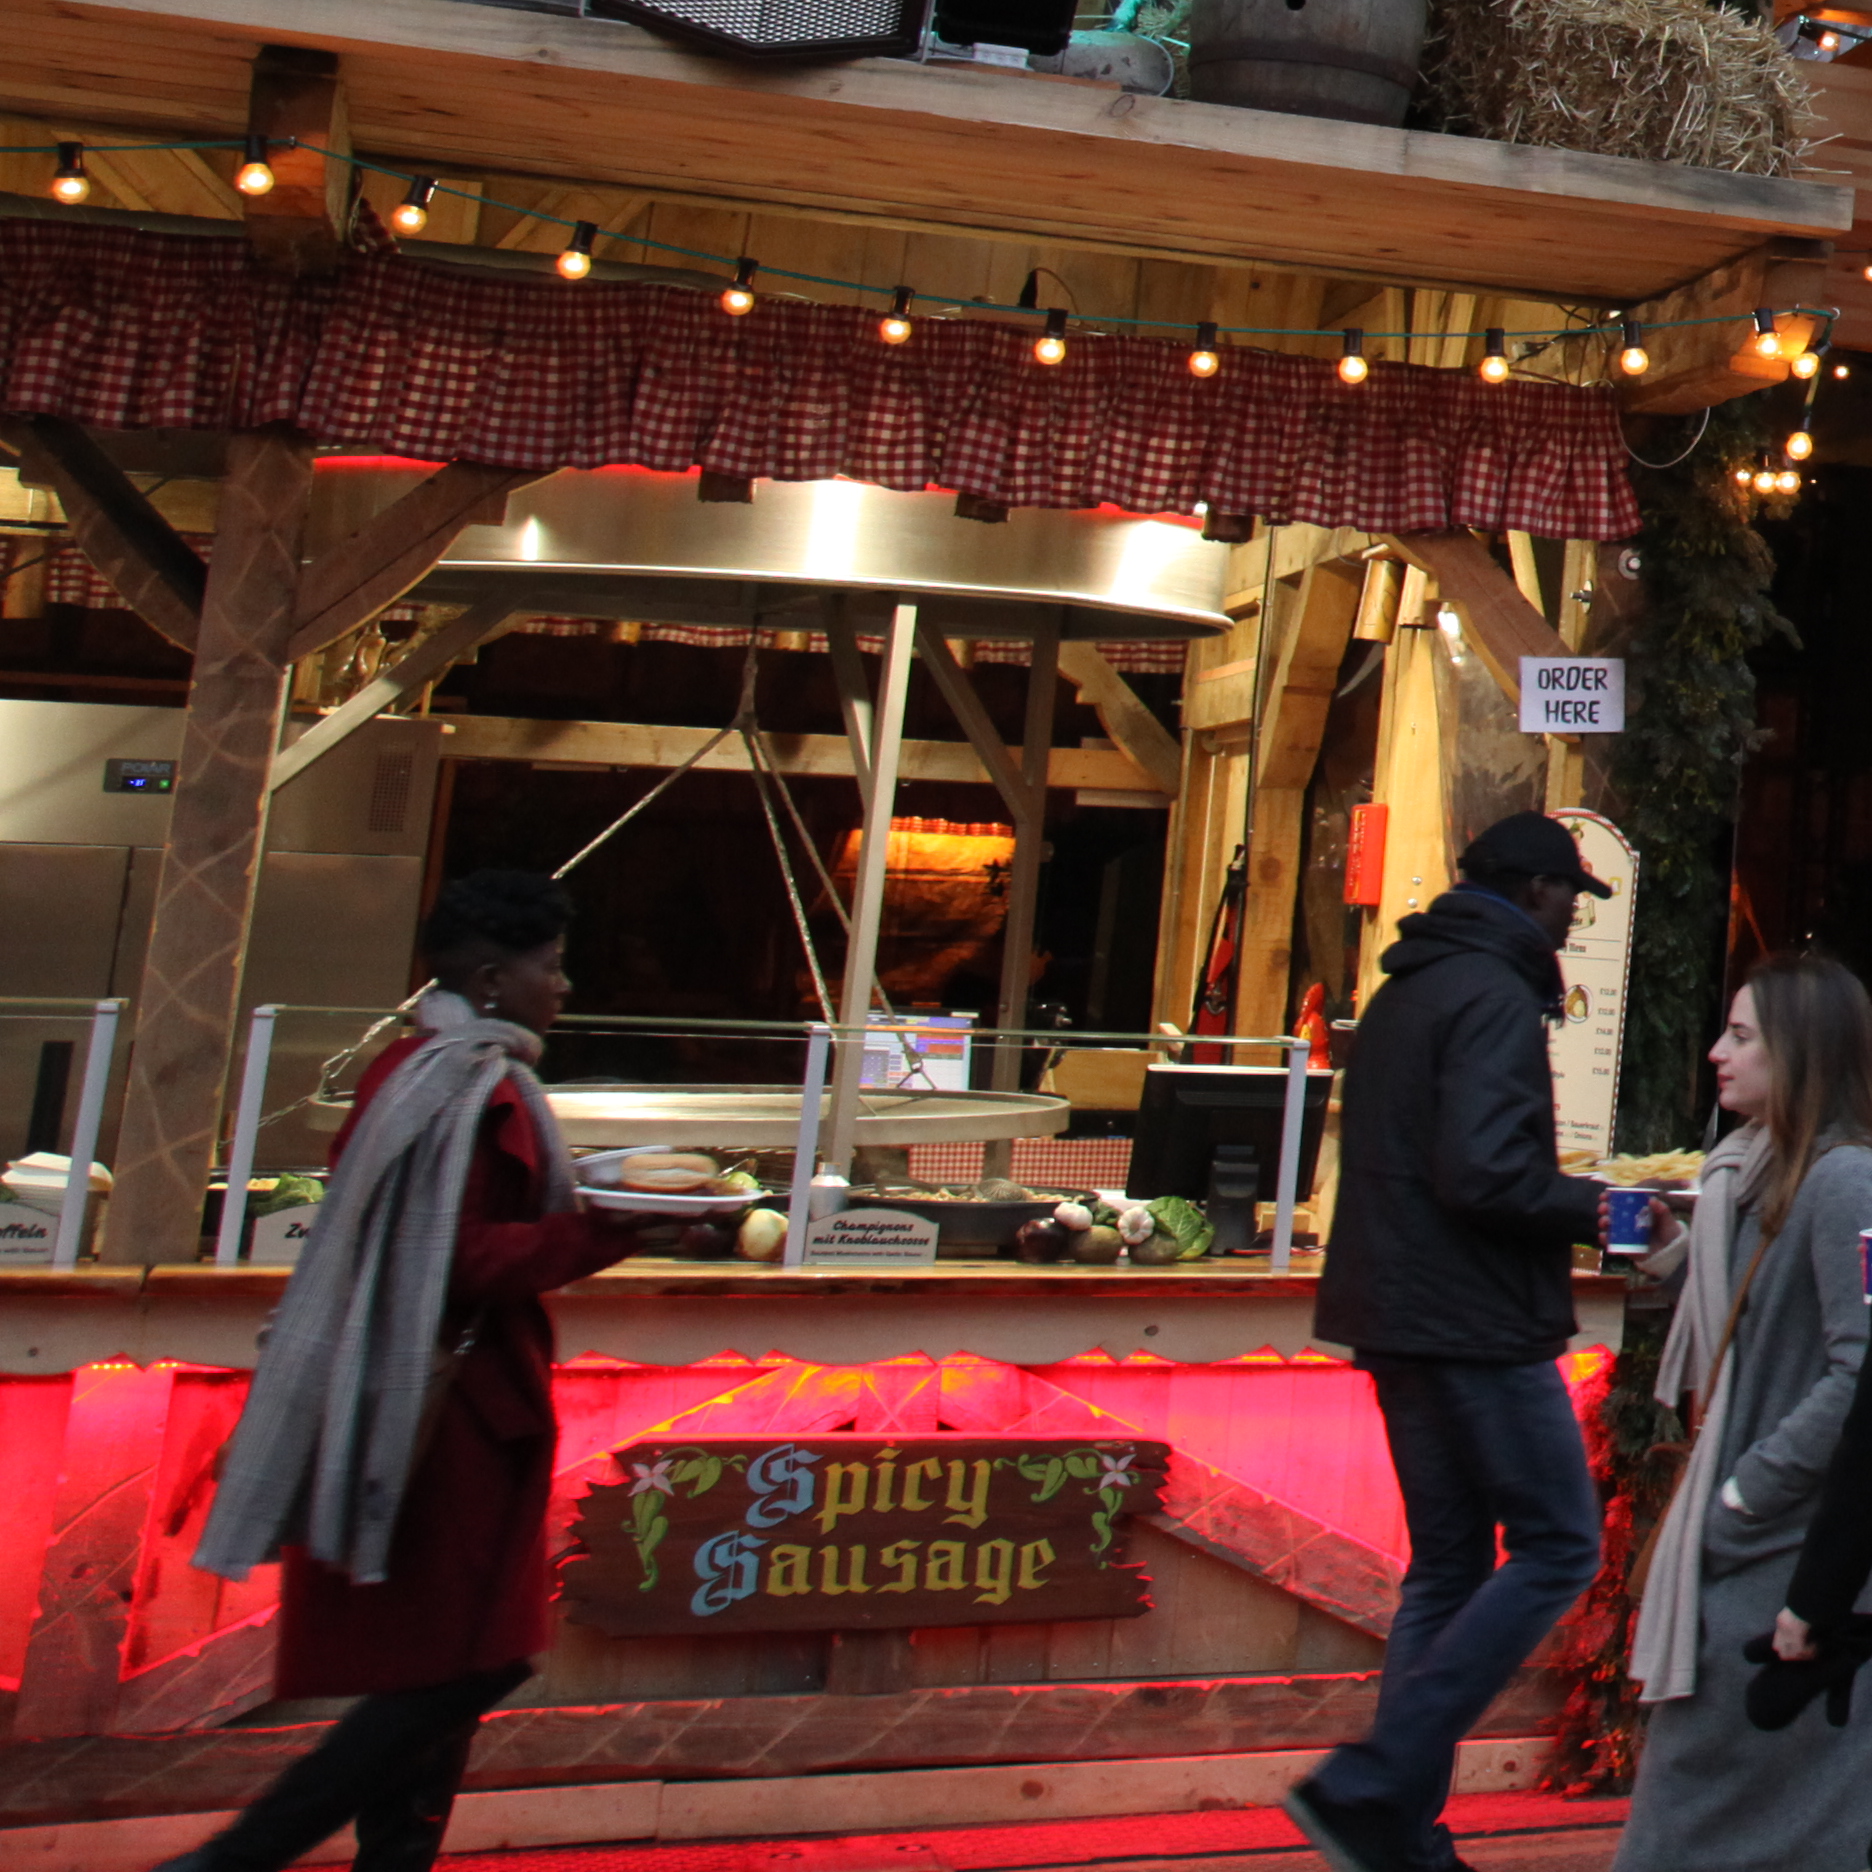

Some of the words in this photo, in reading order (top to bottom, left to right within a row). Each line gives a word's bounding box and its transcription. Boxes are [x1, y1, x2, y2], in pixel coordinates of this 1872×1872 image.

[1536, 665, 1610, 693] ORDER
[1544, 699, 1602, 725] HERE
[812, 1234, 836, 1245] mit
[832, 1220, 914, 1235] Champignons
[745, 1443, 992, 1534] Spicy
[690, 1529, 1056, 1618] Sausage
